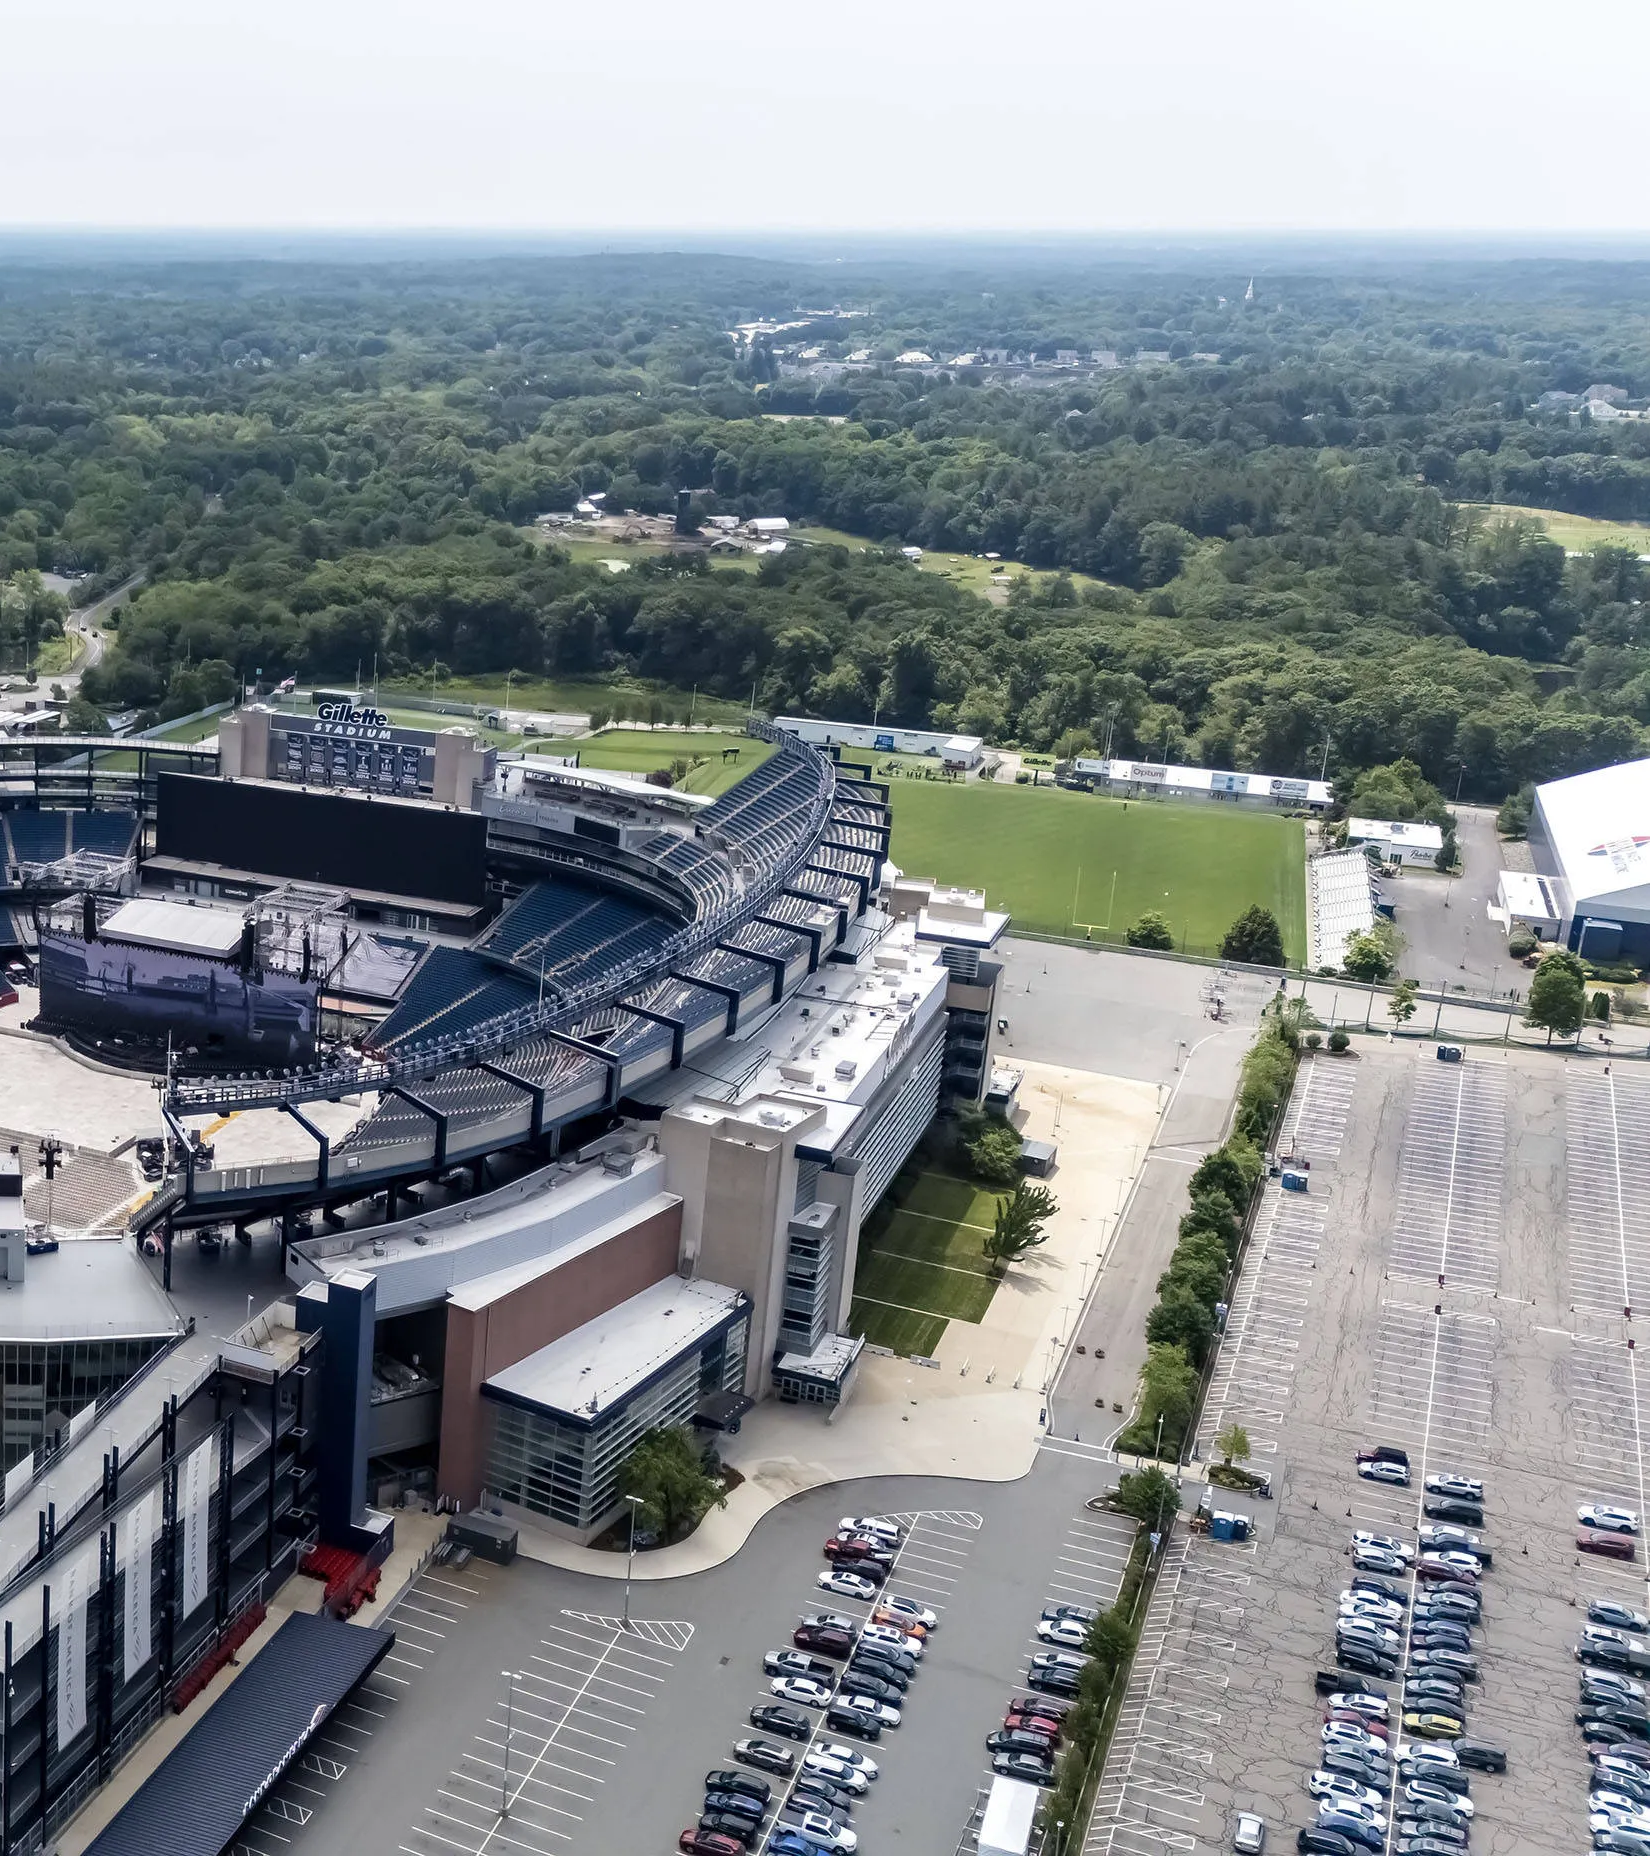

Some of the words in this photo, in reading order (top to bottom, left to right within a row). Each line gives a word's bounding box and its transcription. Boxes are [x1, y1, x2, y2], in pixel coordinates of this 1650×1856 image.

[318, 703, 388, 727] Gillette
[314, 722, 392, 740] STADIUM
[1023, 757, 1052, 767] Gillette
[1133, 768, 1165, 778] Optum
